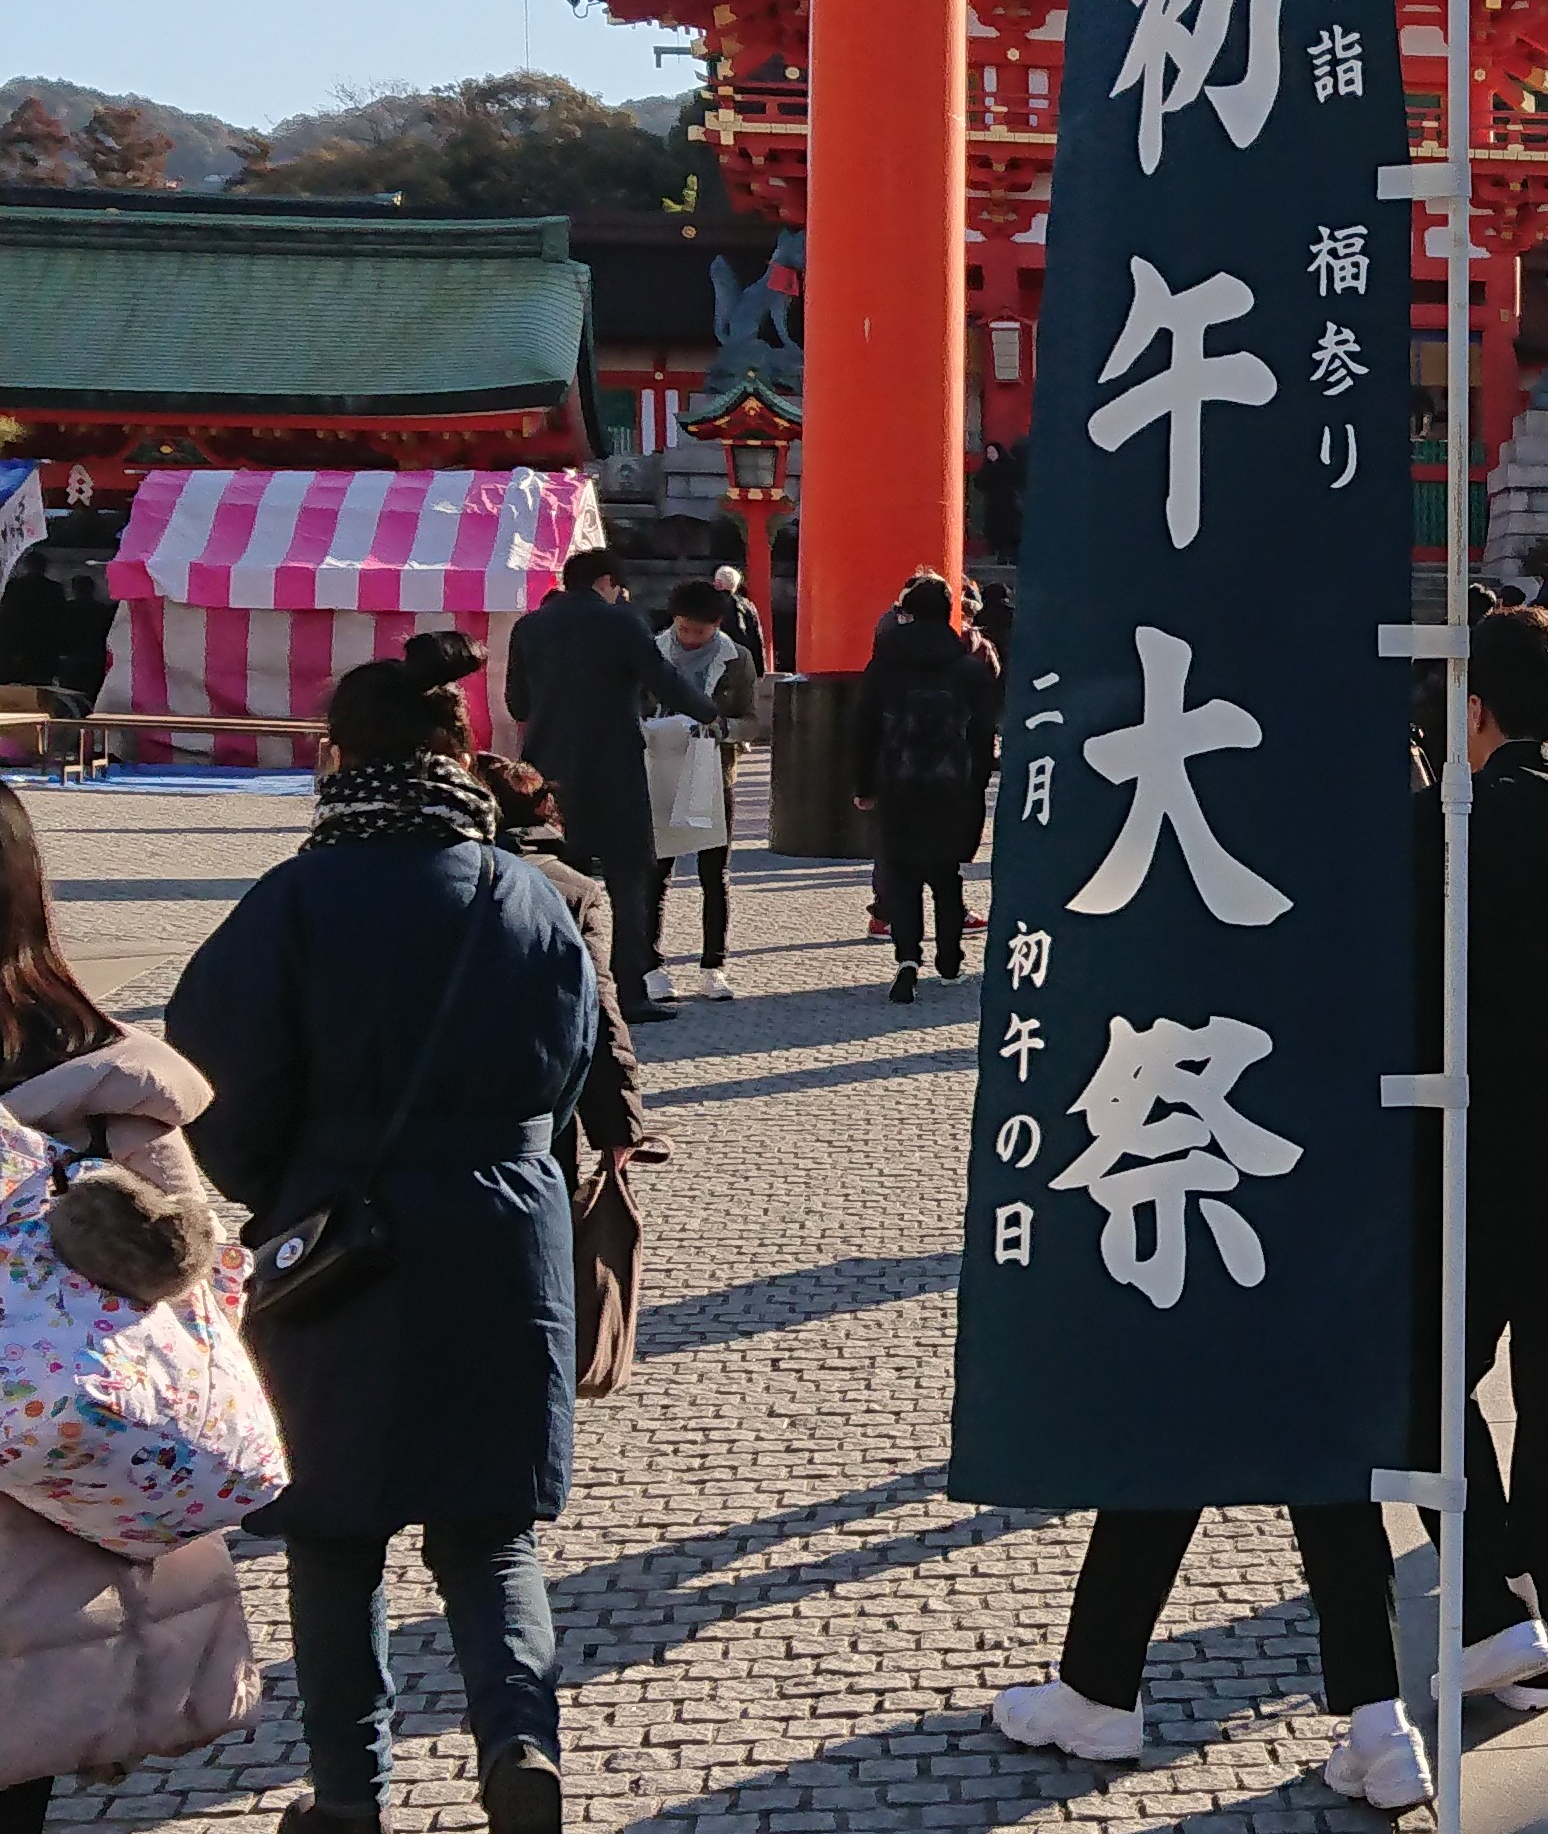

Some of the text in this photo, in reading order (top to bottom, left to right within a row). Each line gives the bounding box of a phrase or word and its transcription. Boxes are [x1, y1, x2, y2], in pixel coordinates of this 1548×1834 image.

[1306, 224, 1370, 489] 福参り
[994, 671, 1064, 1267] 二月 初午の日
